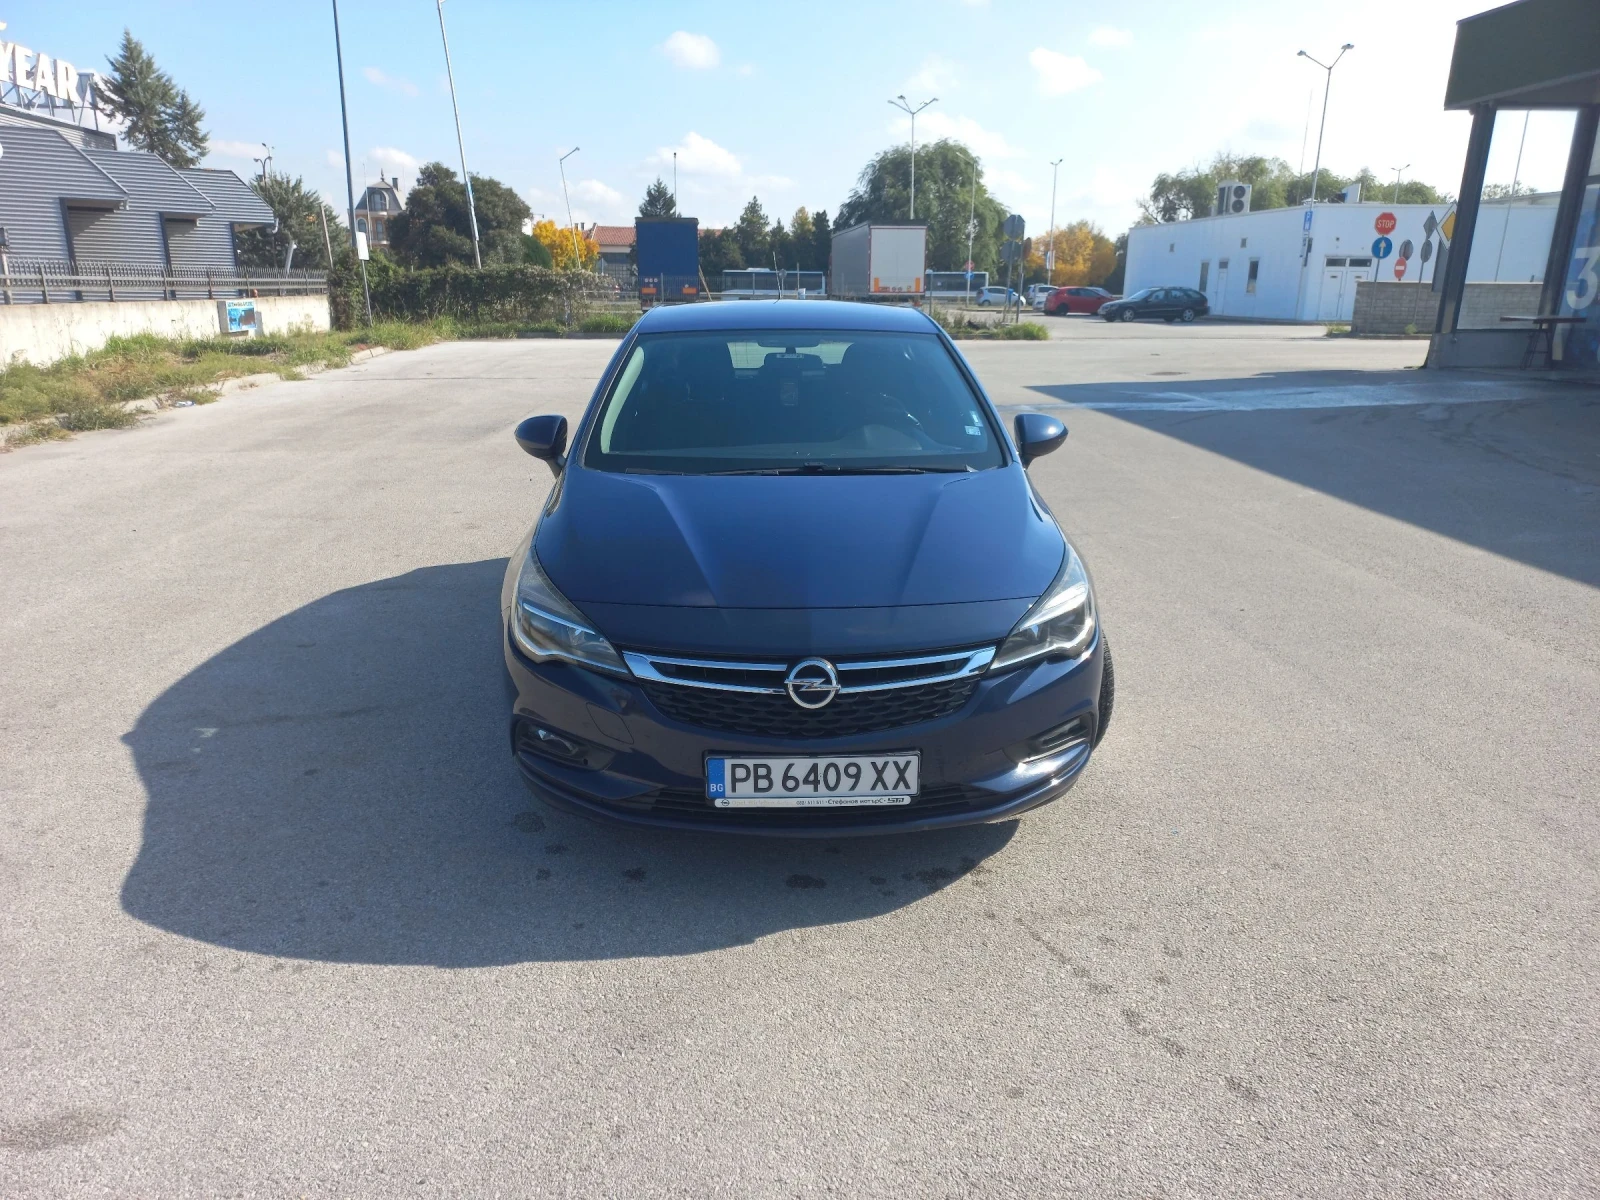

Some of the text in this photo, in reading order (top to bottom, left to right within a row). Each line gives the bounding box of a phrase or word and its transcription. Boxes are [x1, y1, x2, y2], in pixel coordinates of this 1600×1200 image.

[1377, 219, 1395, 228] STOP
[1566, 246, 1600, 310] 3
[731, 760, 912, 793] PB 6409 XX
[710, 783, 724, 792] BG
